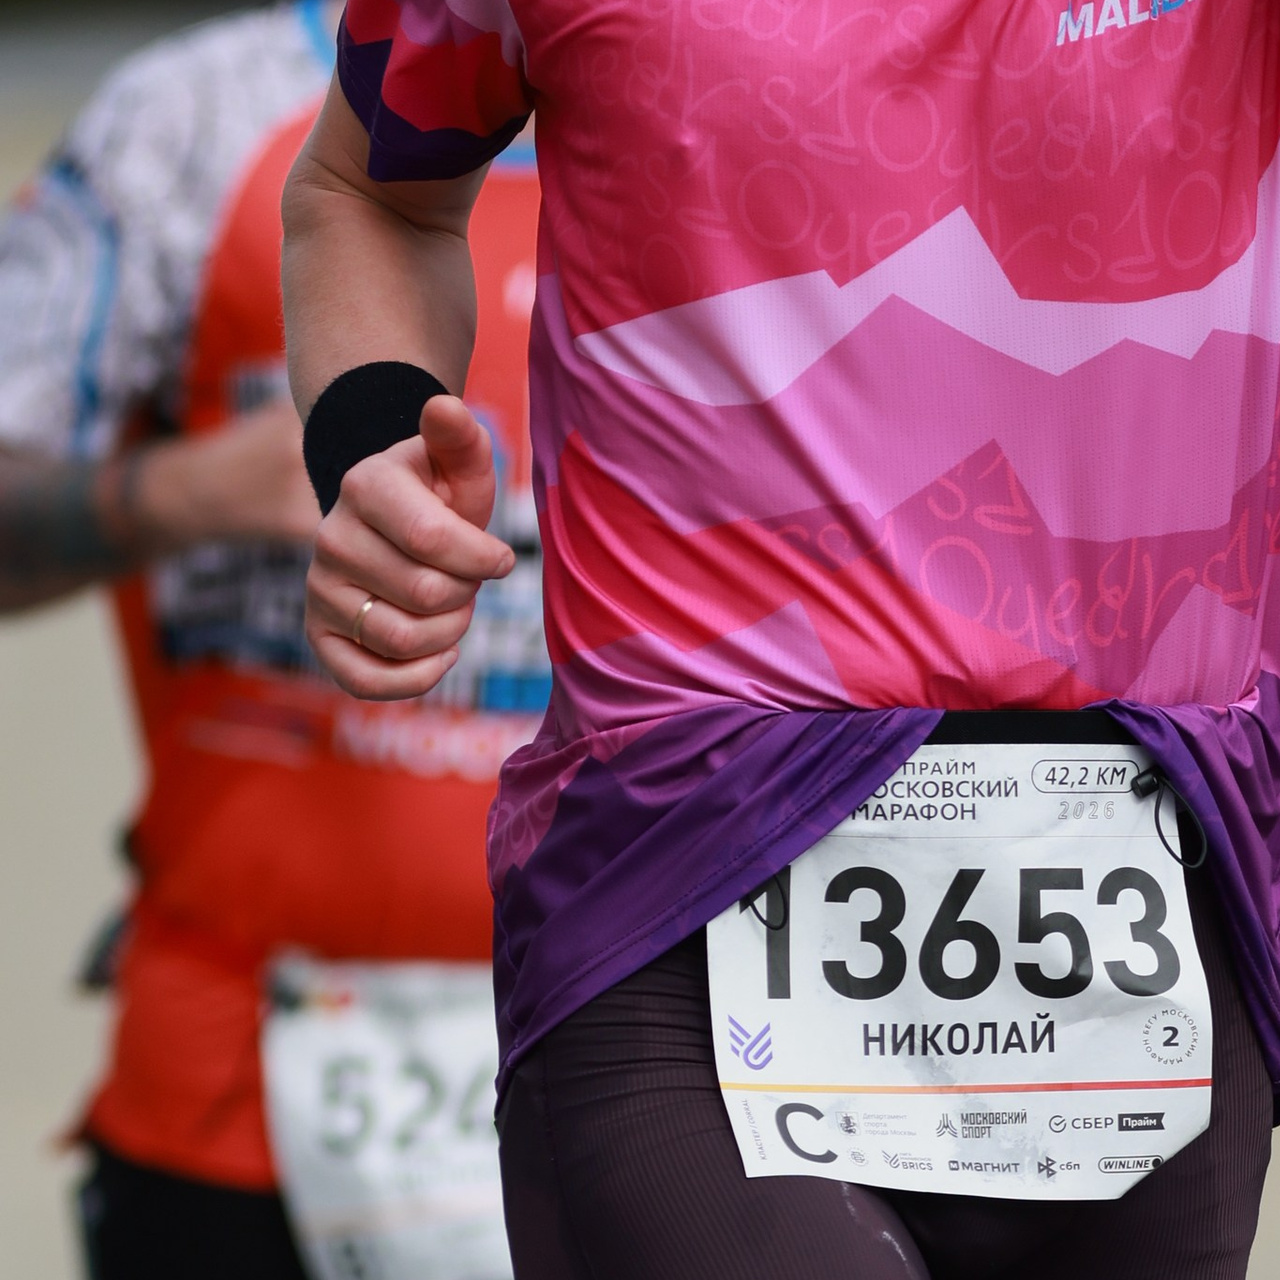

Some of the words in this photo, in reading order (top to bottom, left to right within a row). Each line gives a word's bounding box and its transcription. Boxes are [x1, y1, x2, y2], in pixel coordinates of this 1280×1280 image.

[902, 758, 976, 776] ПРАЙМ
[1044, 766, 1088, 788] 42,2
[872, 776, 1019, 799] ОСКОВСКИЙ
[851, 802, 976, 821] МАРАФОН
[1058, 800, 1115, 820] 2026
[739, 865, 1181, 1000] 13653
[862, 1012, 1056, 1057] НИКОЛАЙ
[1161, 1008, 1199, 1058] МОСКОВСКИЙ
[1162, 1025, 1180, 1047] 2
[1142, 1038, 1183, 1065] МАРАФОН
[960, 1108, 1028, 1126] МОСКОВСКИЙ
[1071, 1117, 1114, 1130] СБЕР
[1122, 1116, 1157, 1128] Прайм
[774, 1102, 839, 1164] C
[961, 1126, 992, 1139] СПОРТ
[901, 1161, 933, 1171] BRICS
[1059, 1161, 1081, 1172] сбп
[1103, 1158, 1151, 1171] WINLINE
